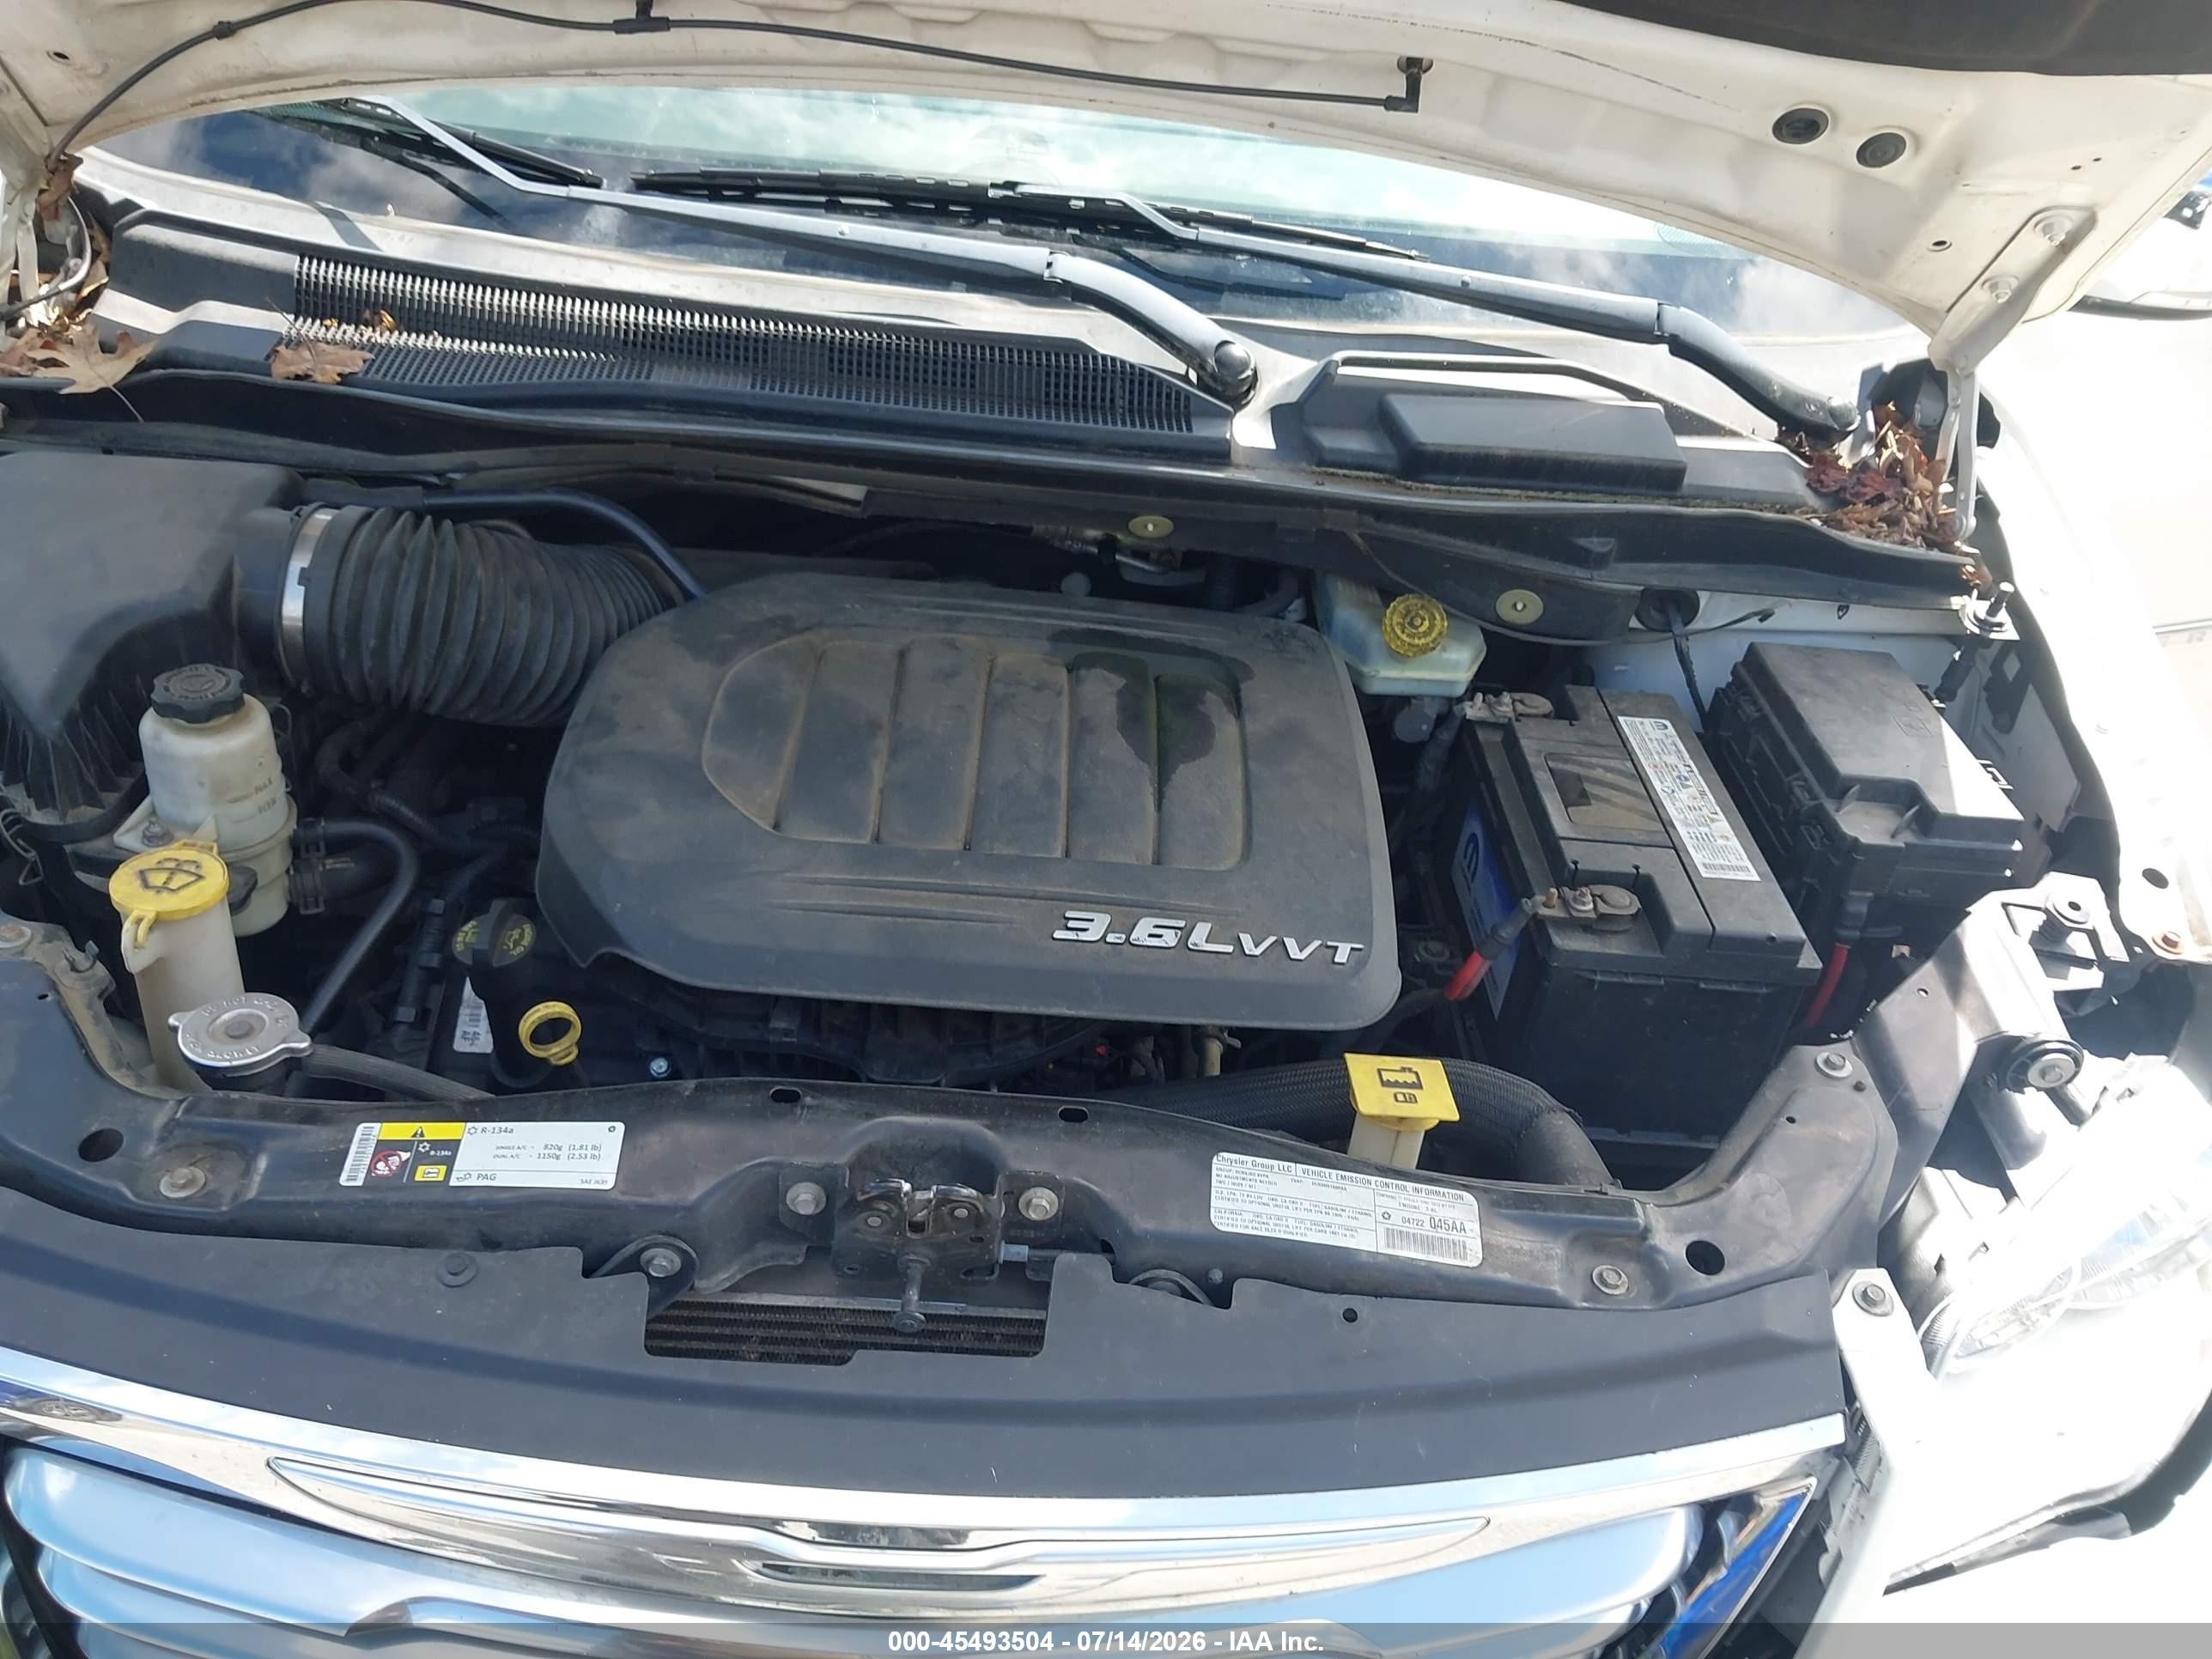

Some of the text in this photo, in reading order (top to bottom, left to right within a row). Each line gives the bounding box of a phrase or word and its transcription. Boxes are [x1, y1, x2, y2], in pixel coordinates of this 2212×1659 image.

[1052, 908, 1365, 965] 3.6L VVT
[481, 1126, 514, 1134] R-134a
[544, 1144, 563, 1152] 820g
[537, 1152, 562, 1161] 1150g
[568, 1152, 588, 1161] (2.53
[590, 1152, 601, 1161] lb)
[1216, 1153, 1292, 1173] Chrysler Group LLC
[477, 1173, 498, 1182] PAG
[1301, 1167, 1334, 1181] VEHICLE
[1335, 1173, 1372, 1186] EMISSION
[1374, 1180, 1410, 1193] CONTROL
[1412, 1185, 1464, 1202] INFORMATION
[1401, 1216, 1425, 1228] 04722
